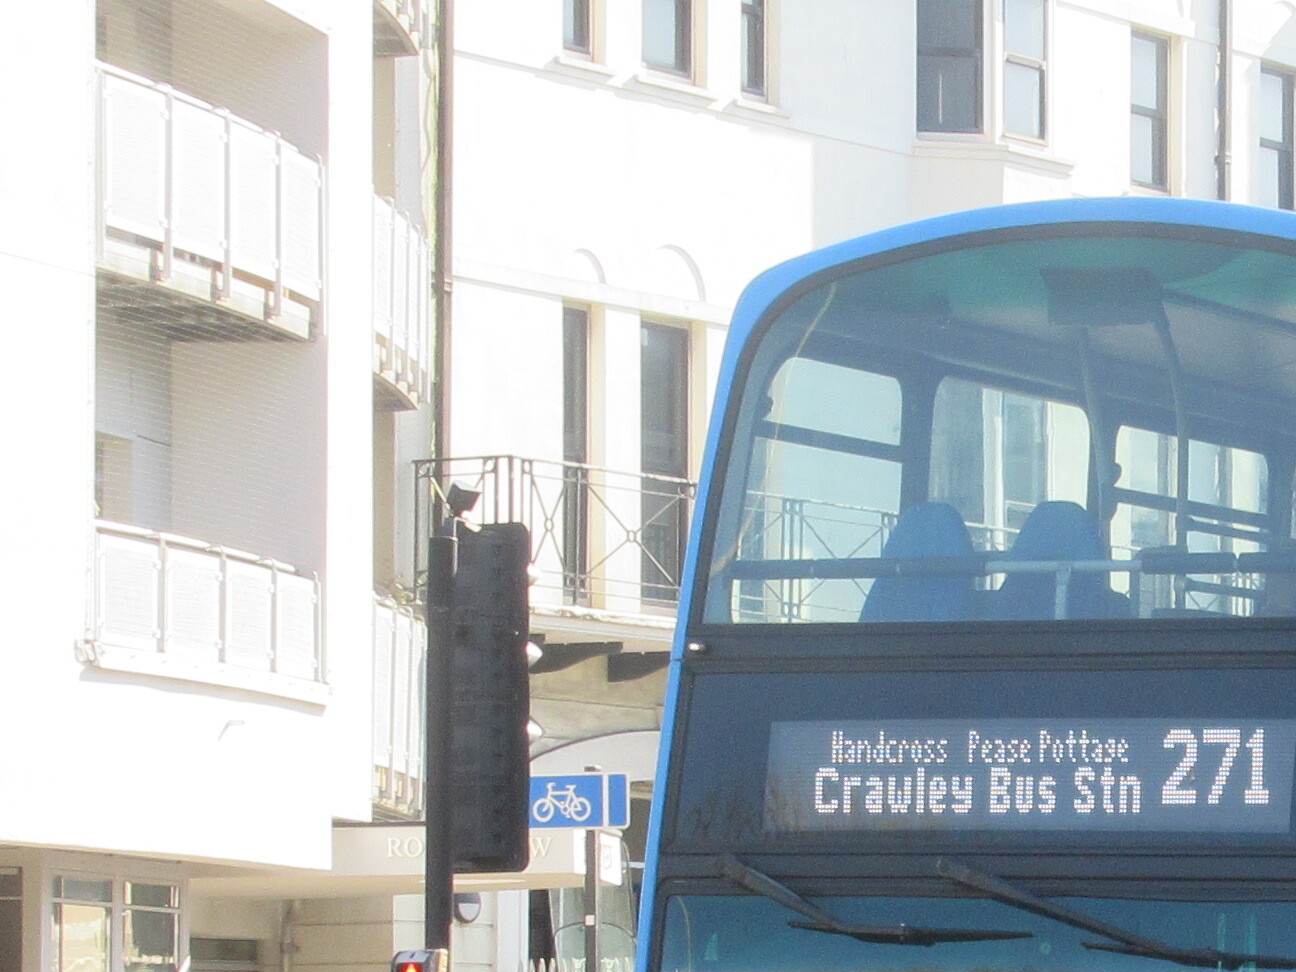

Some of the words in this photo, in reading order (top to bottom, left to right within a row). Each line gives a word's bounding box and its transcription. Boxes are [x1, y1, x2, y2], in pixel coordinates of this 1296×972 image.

[831, 730, 948, 763] Handcross
[968, 730, 1031, 763] Pease
[1038, 730, 1130, 763] Pottage
[1160, 728, 1270, 805] 271
[813, 767, 974, 813] Crawley
[988, 767, 1057, 813] Bus
[1073, 767, 1142, 813] Stn
